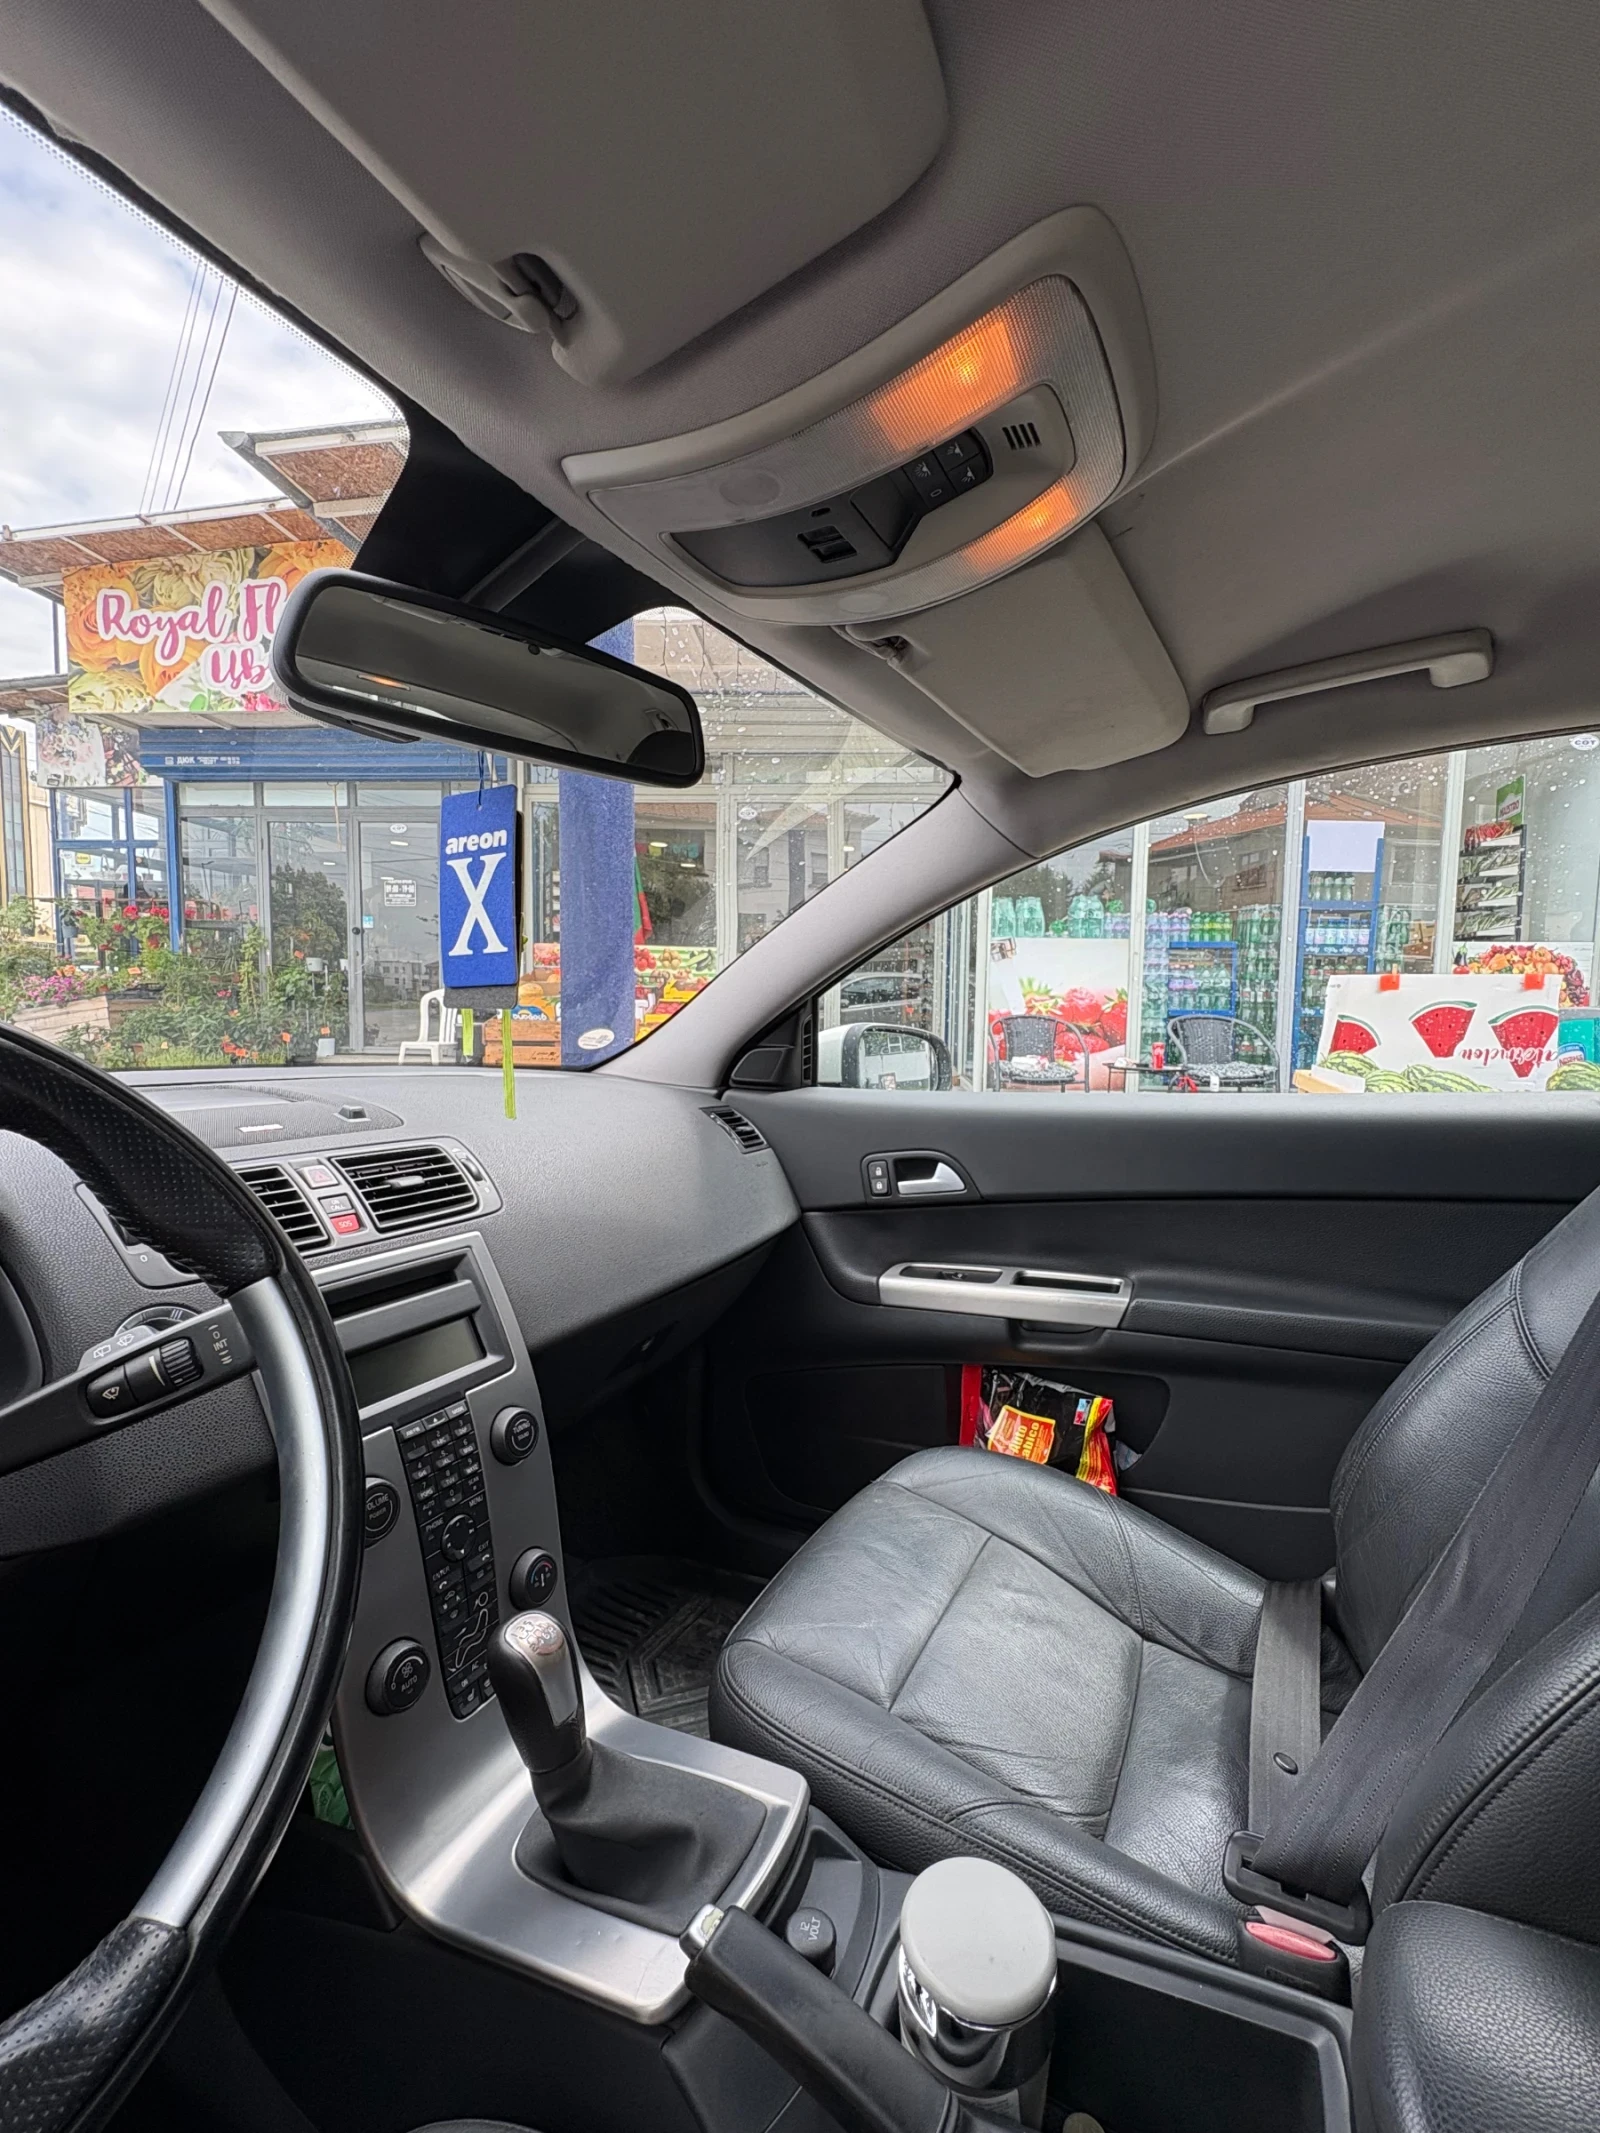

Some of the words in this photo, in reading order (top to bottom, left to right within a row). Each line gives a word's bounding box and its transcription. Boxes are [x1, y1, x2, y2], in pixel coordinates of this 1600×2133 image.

[102, 585, 227, 661] Royal
[243, 582, 281, 642] Fl
[211, 648, 270, 690] Цв
[445, 829, 508, 855] areon
[446, 852, 508, 957] X
[1460, 1046, 1559, 1067] atermelon
[338, 1220, 353, 1229] SOS
[213, 1338, 228, 1351] INT
[366, 1493, 389, 1511] OLUME
[468, 1494, 484, 1508] MENU
[425, 1517, 444, 1533] PHONE
[432, 1565, 450, 1581] ENTER
[401, 1674, 418, 1692] AUTO
[800, 1921, 810, 1931] 12
[807, 1916, 821, 1941] VOLT
